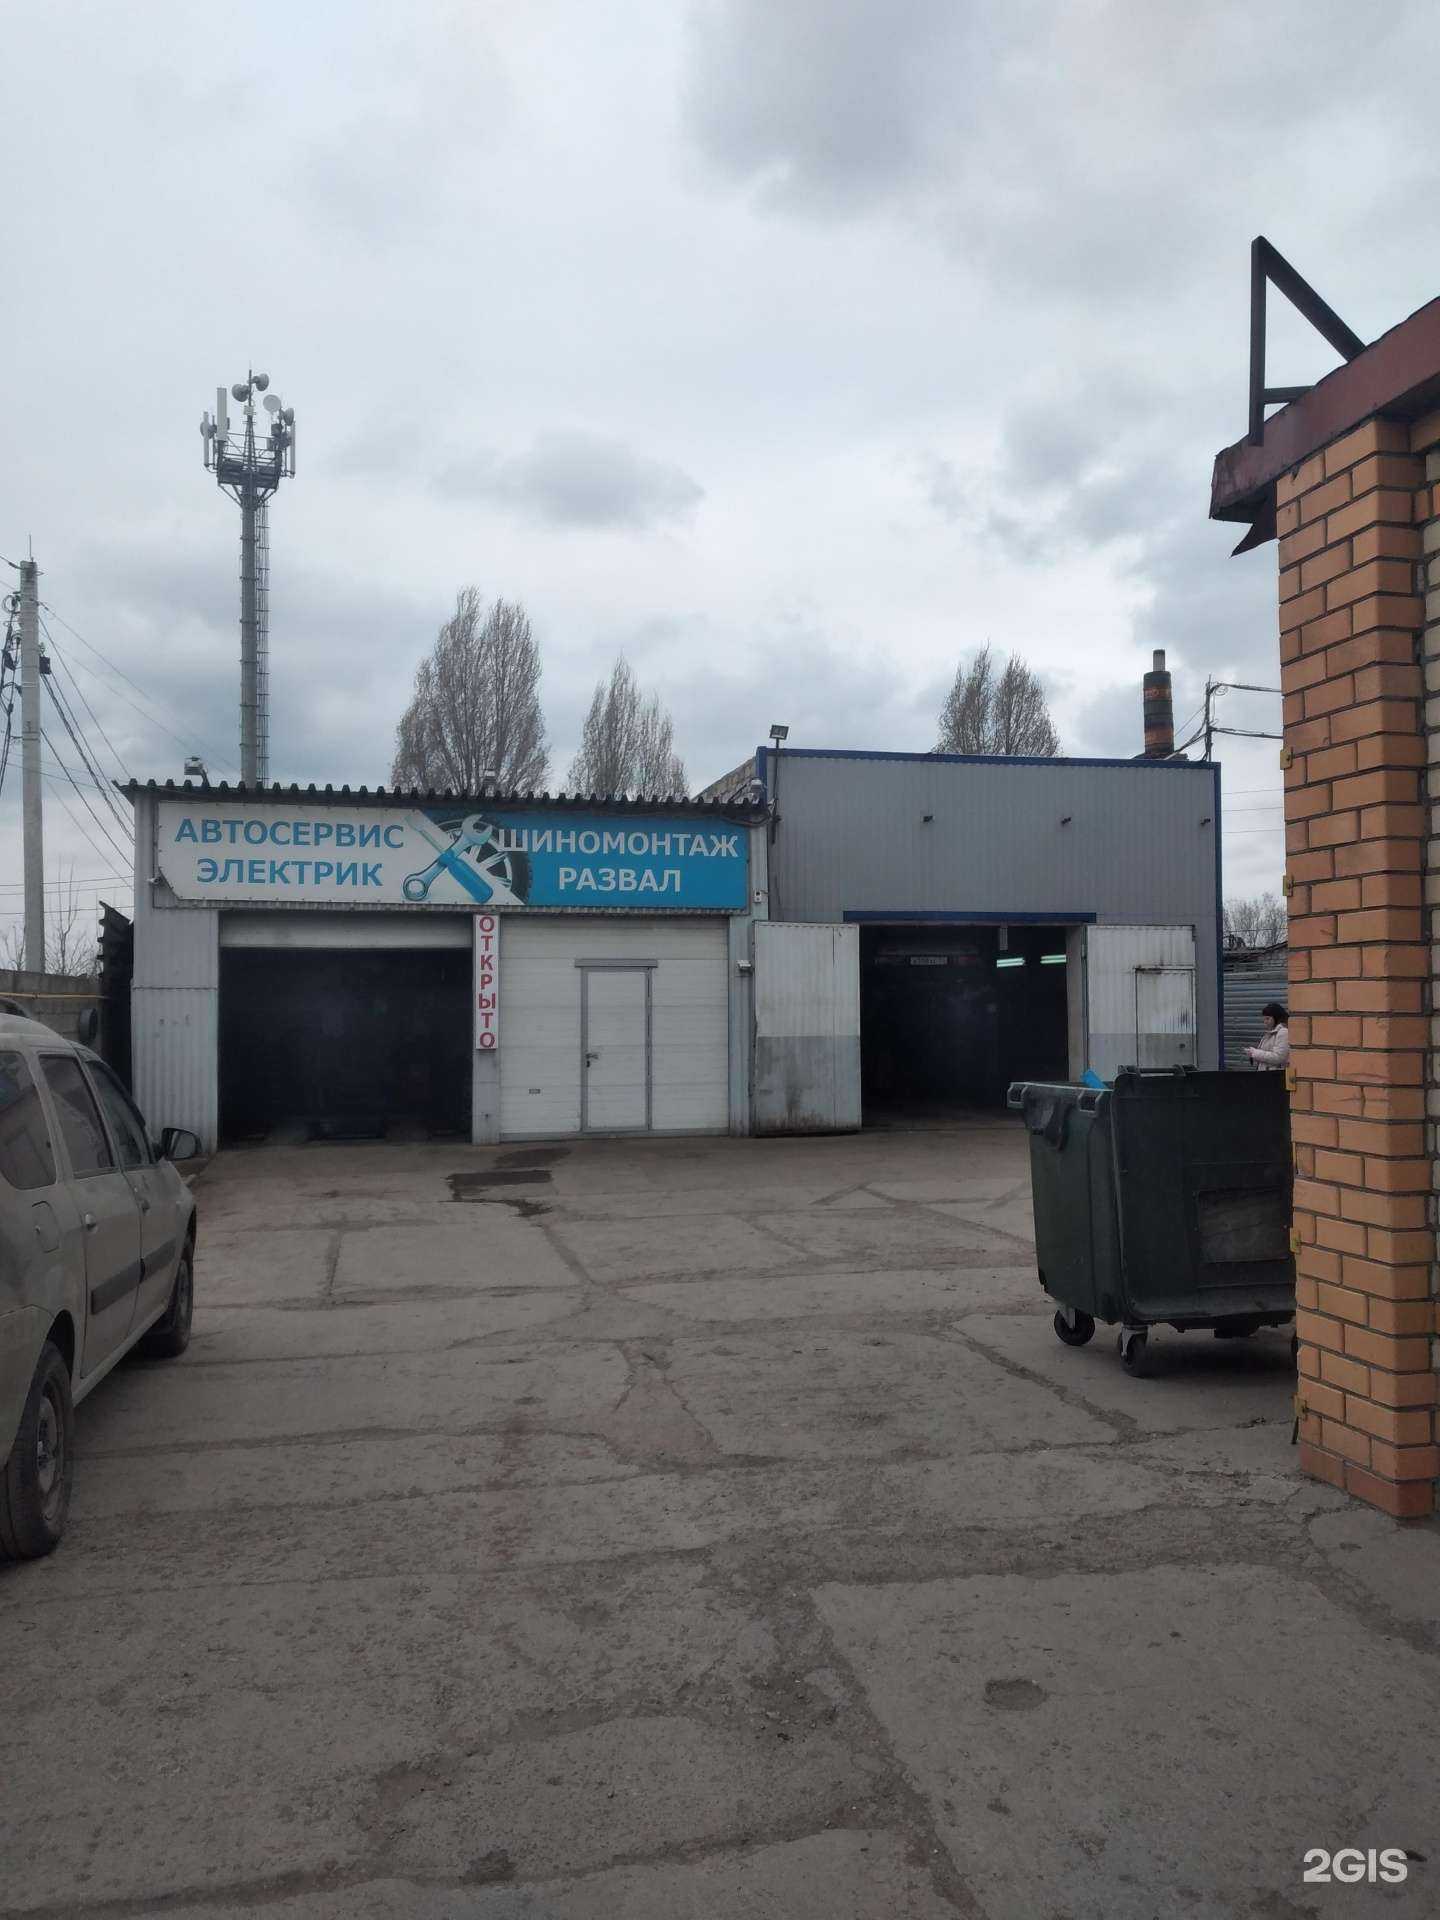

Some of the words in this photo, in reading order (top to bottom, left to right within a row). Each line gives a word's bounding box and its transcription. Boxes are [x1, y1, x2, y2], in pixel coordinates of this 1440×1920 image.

[174, 818, 404, 849] АВТОСЕРВИС
[498, 829, 738, 857] ШИНОМОНТАЖ
[196, 858, 383, 886] ЭЛЕКТРИК
[558, 867, 681, 893] РАЗВАЛ
[478, 916, 496, 1048] ОТКРЫТО
